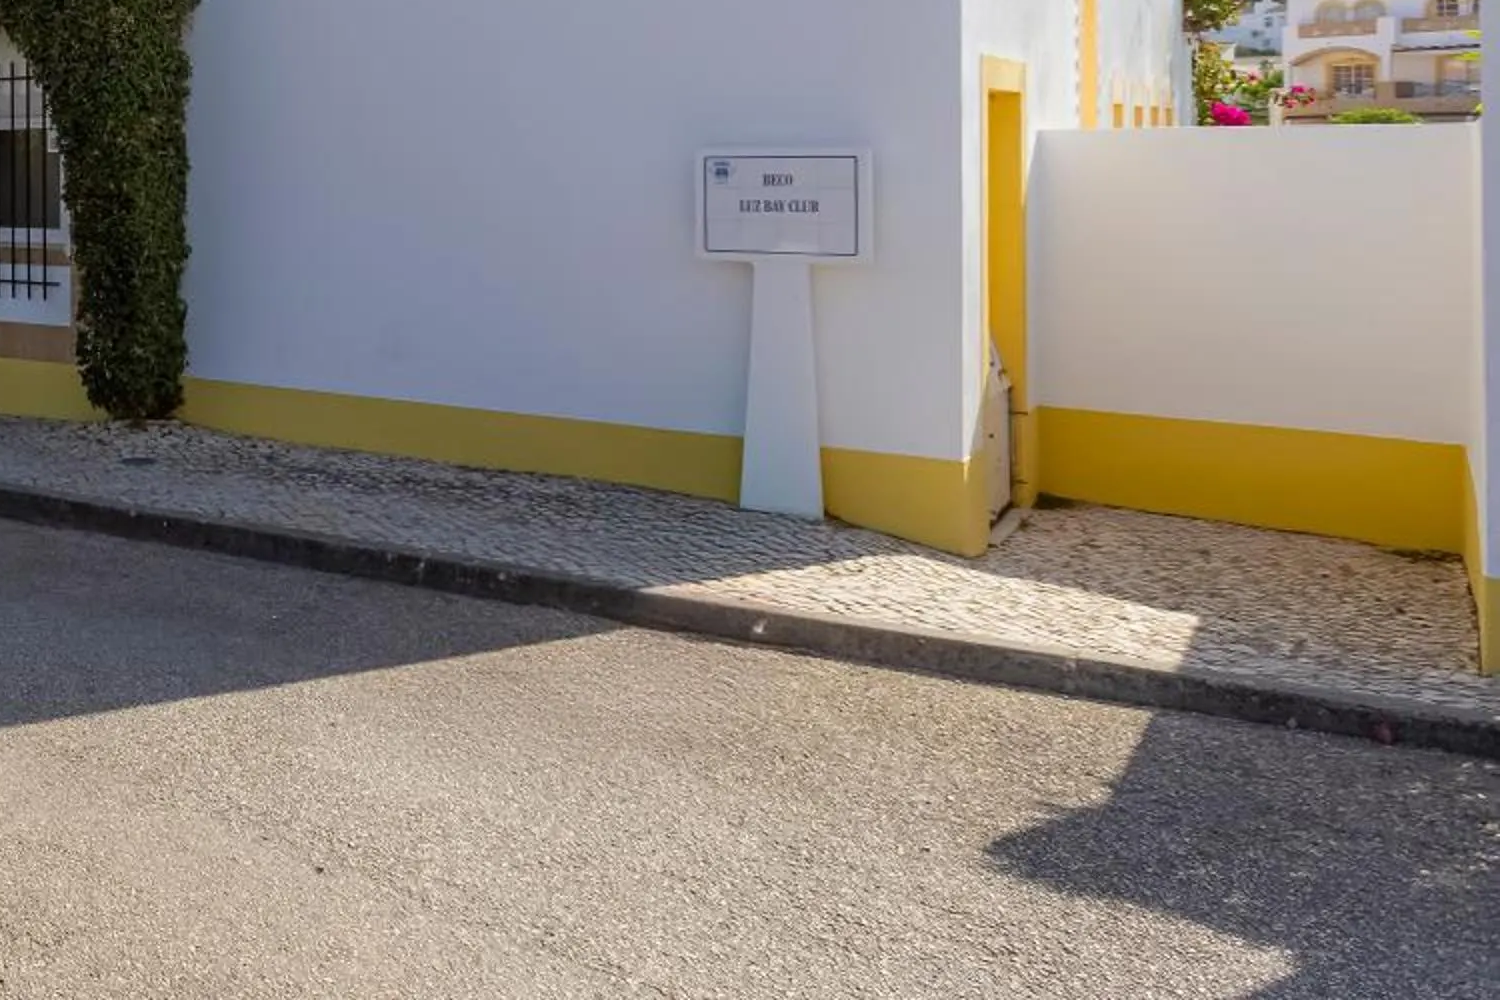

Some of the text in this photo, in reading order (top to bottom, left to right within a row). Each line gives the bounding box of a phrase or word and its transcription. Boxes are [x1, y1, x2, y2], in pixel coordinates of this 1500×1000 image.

[739, 199, 820, 213] LUZ BAY CLUB
